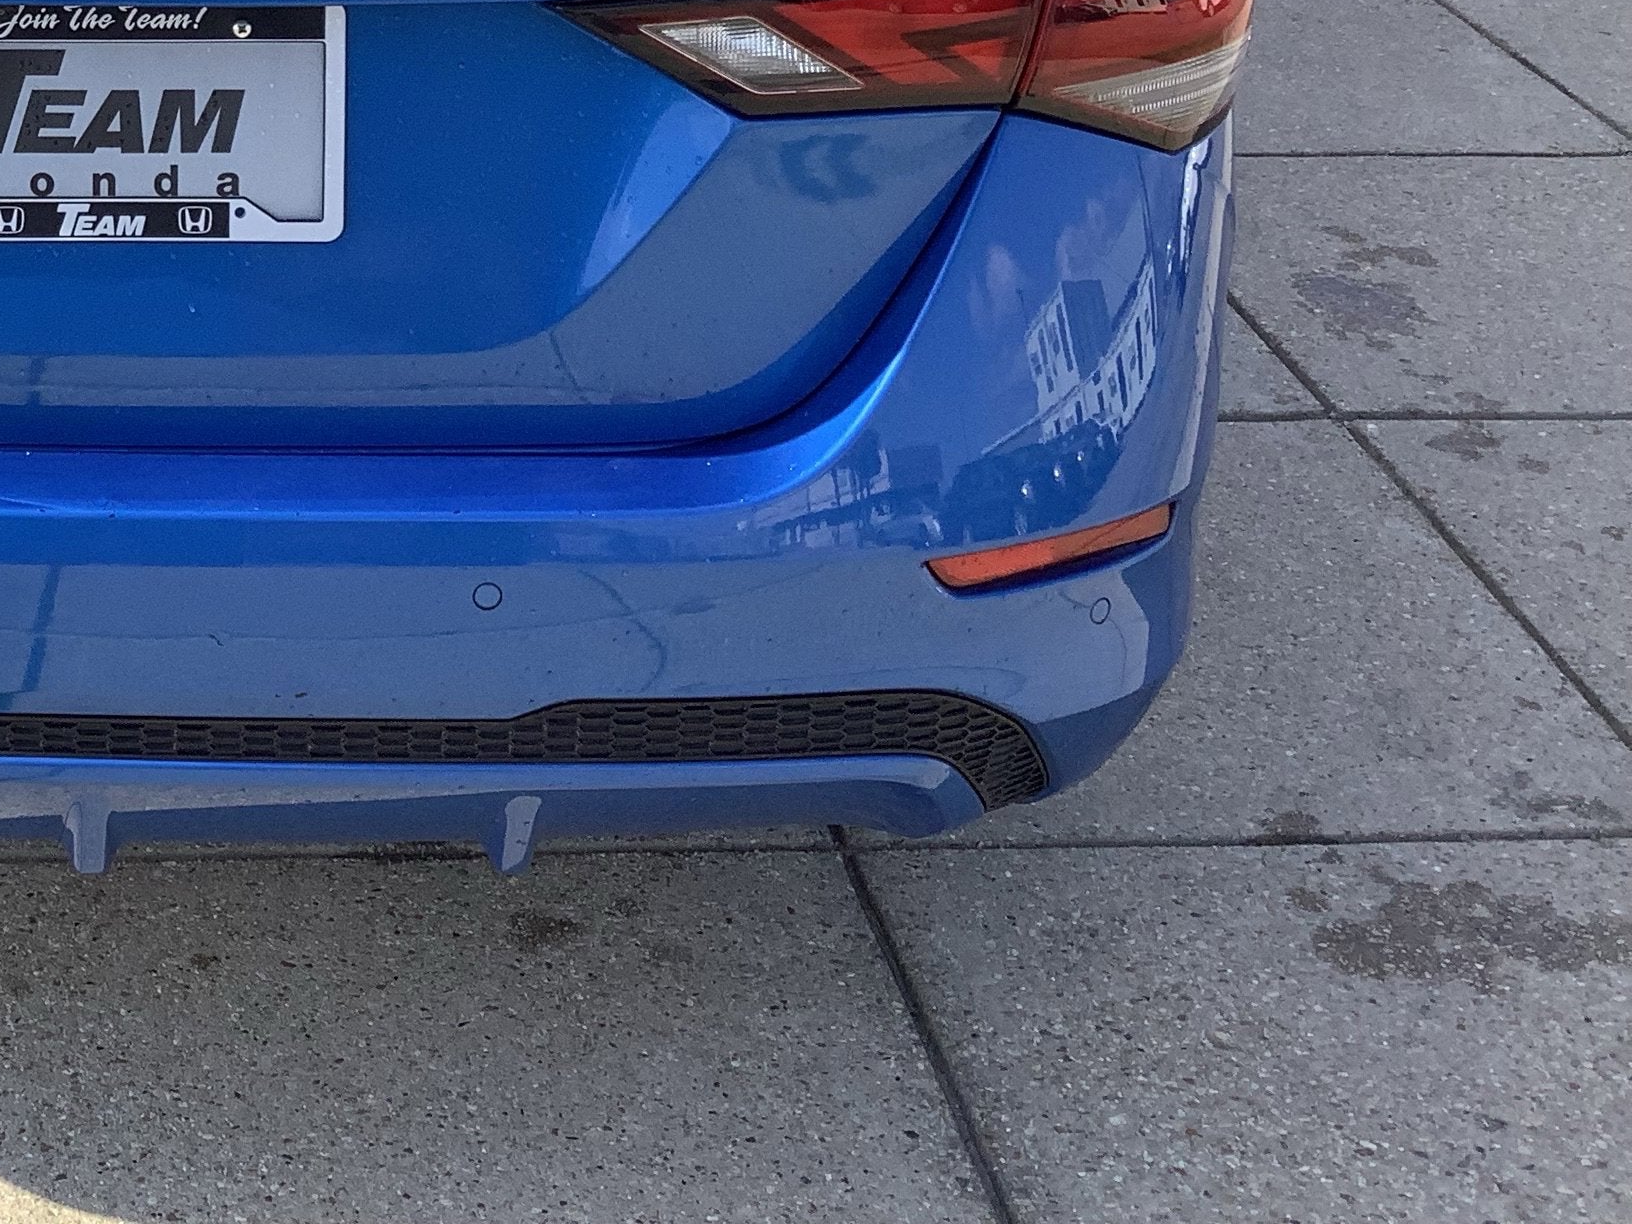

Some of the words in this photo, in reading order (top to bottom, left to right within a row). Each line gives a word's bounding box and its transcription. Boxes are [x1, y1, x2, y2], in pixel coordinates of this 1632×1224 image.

[63, 5, 115, 31] The
[118, 5, 207, 31] Team!
[56, 203, 147, 237] TEAM
